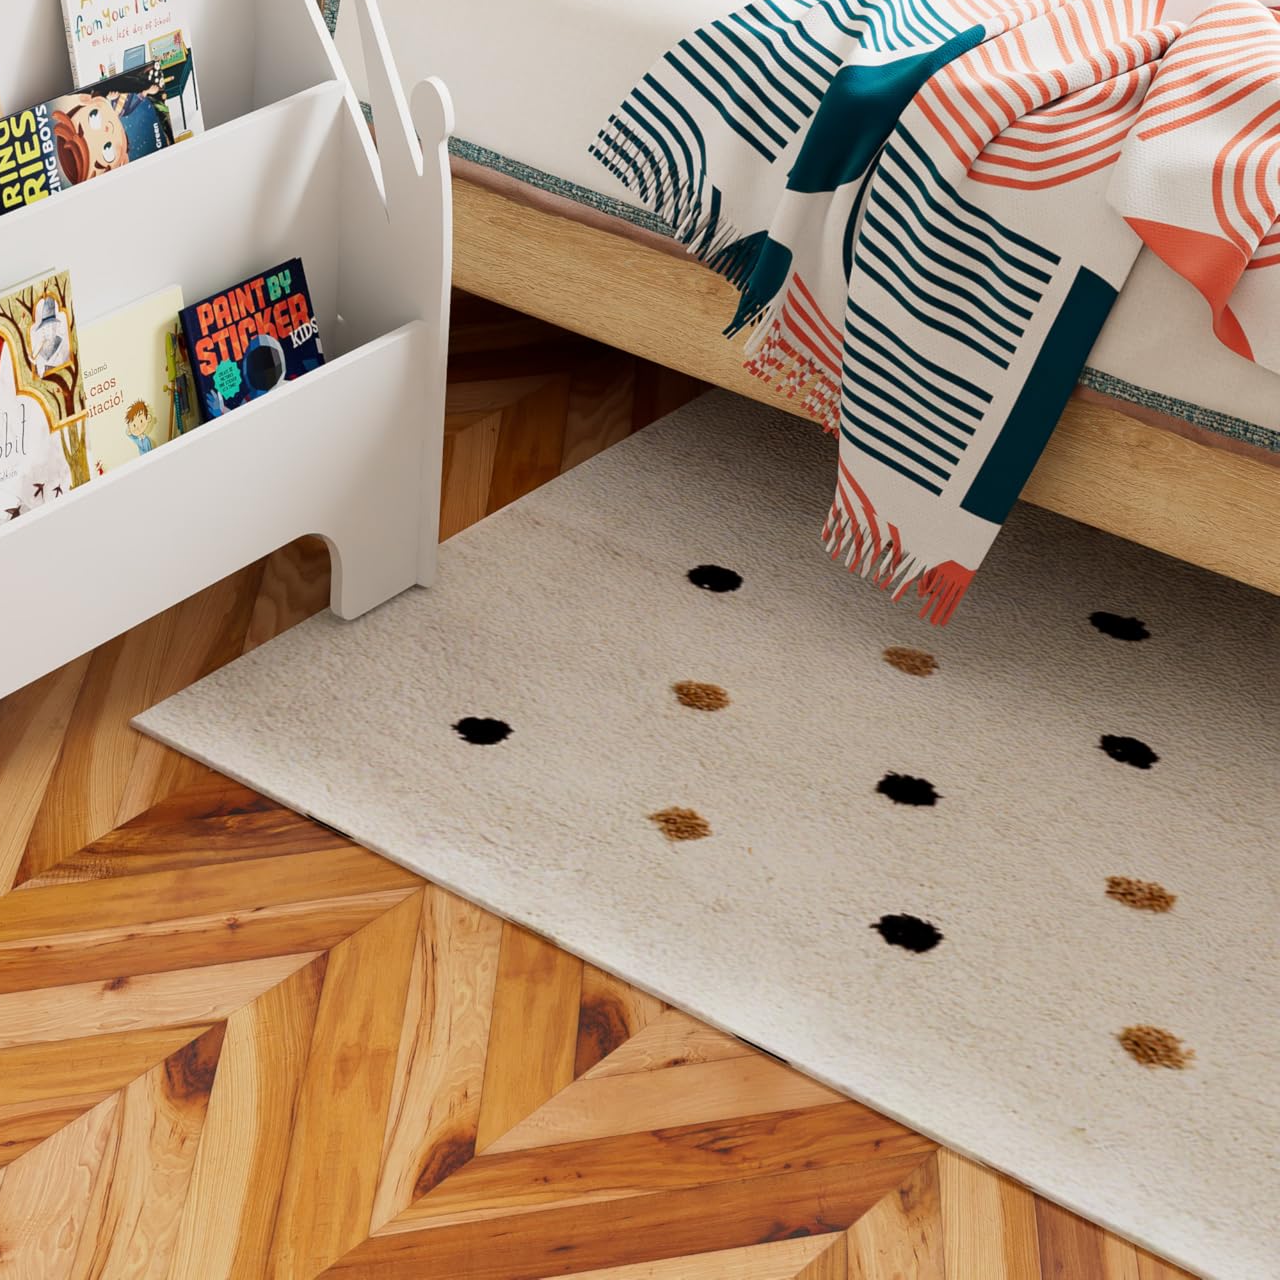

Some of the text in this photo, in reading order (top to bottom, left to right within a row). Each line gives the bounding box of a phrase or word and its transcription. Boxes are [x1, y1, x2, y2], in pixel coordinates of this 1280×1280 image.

[75, 15, 103, 42] from
[35, 104, 54, 154] BOYS
[153, 122, 162, 149] Green
[10, 110, 49, 206] RIES
[196, 269, 292, 336] PAINT BY
[195, 292, 311, 377] STICKER
[289, 315, 319, 349] KIDS
[90, 377, 117, 397] caos
